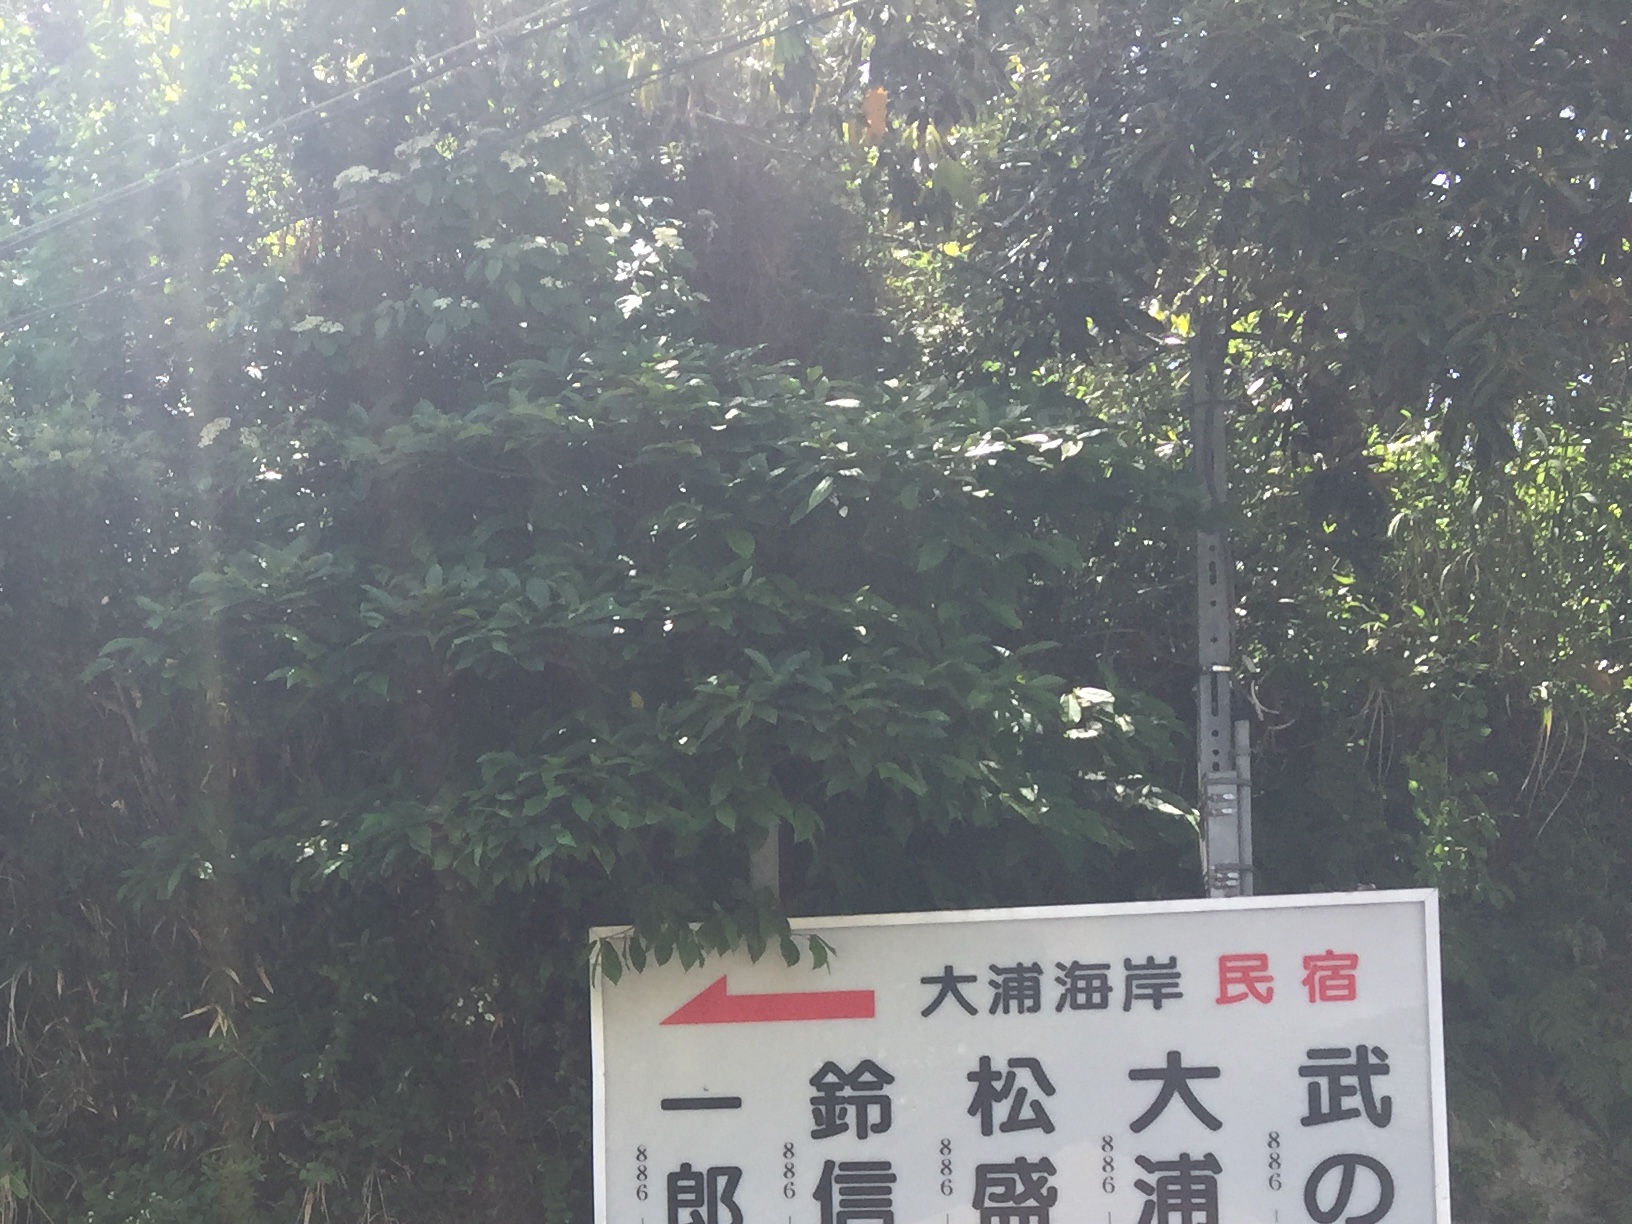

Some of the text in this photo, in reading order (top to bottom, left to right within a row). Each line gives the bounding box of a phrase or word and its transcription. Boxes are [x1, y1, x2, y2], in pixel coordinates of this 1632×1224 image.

[920, 949, 1361, 1019] 大浦海岸 民宿
